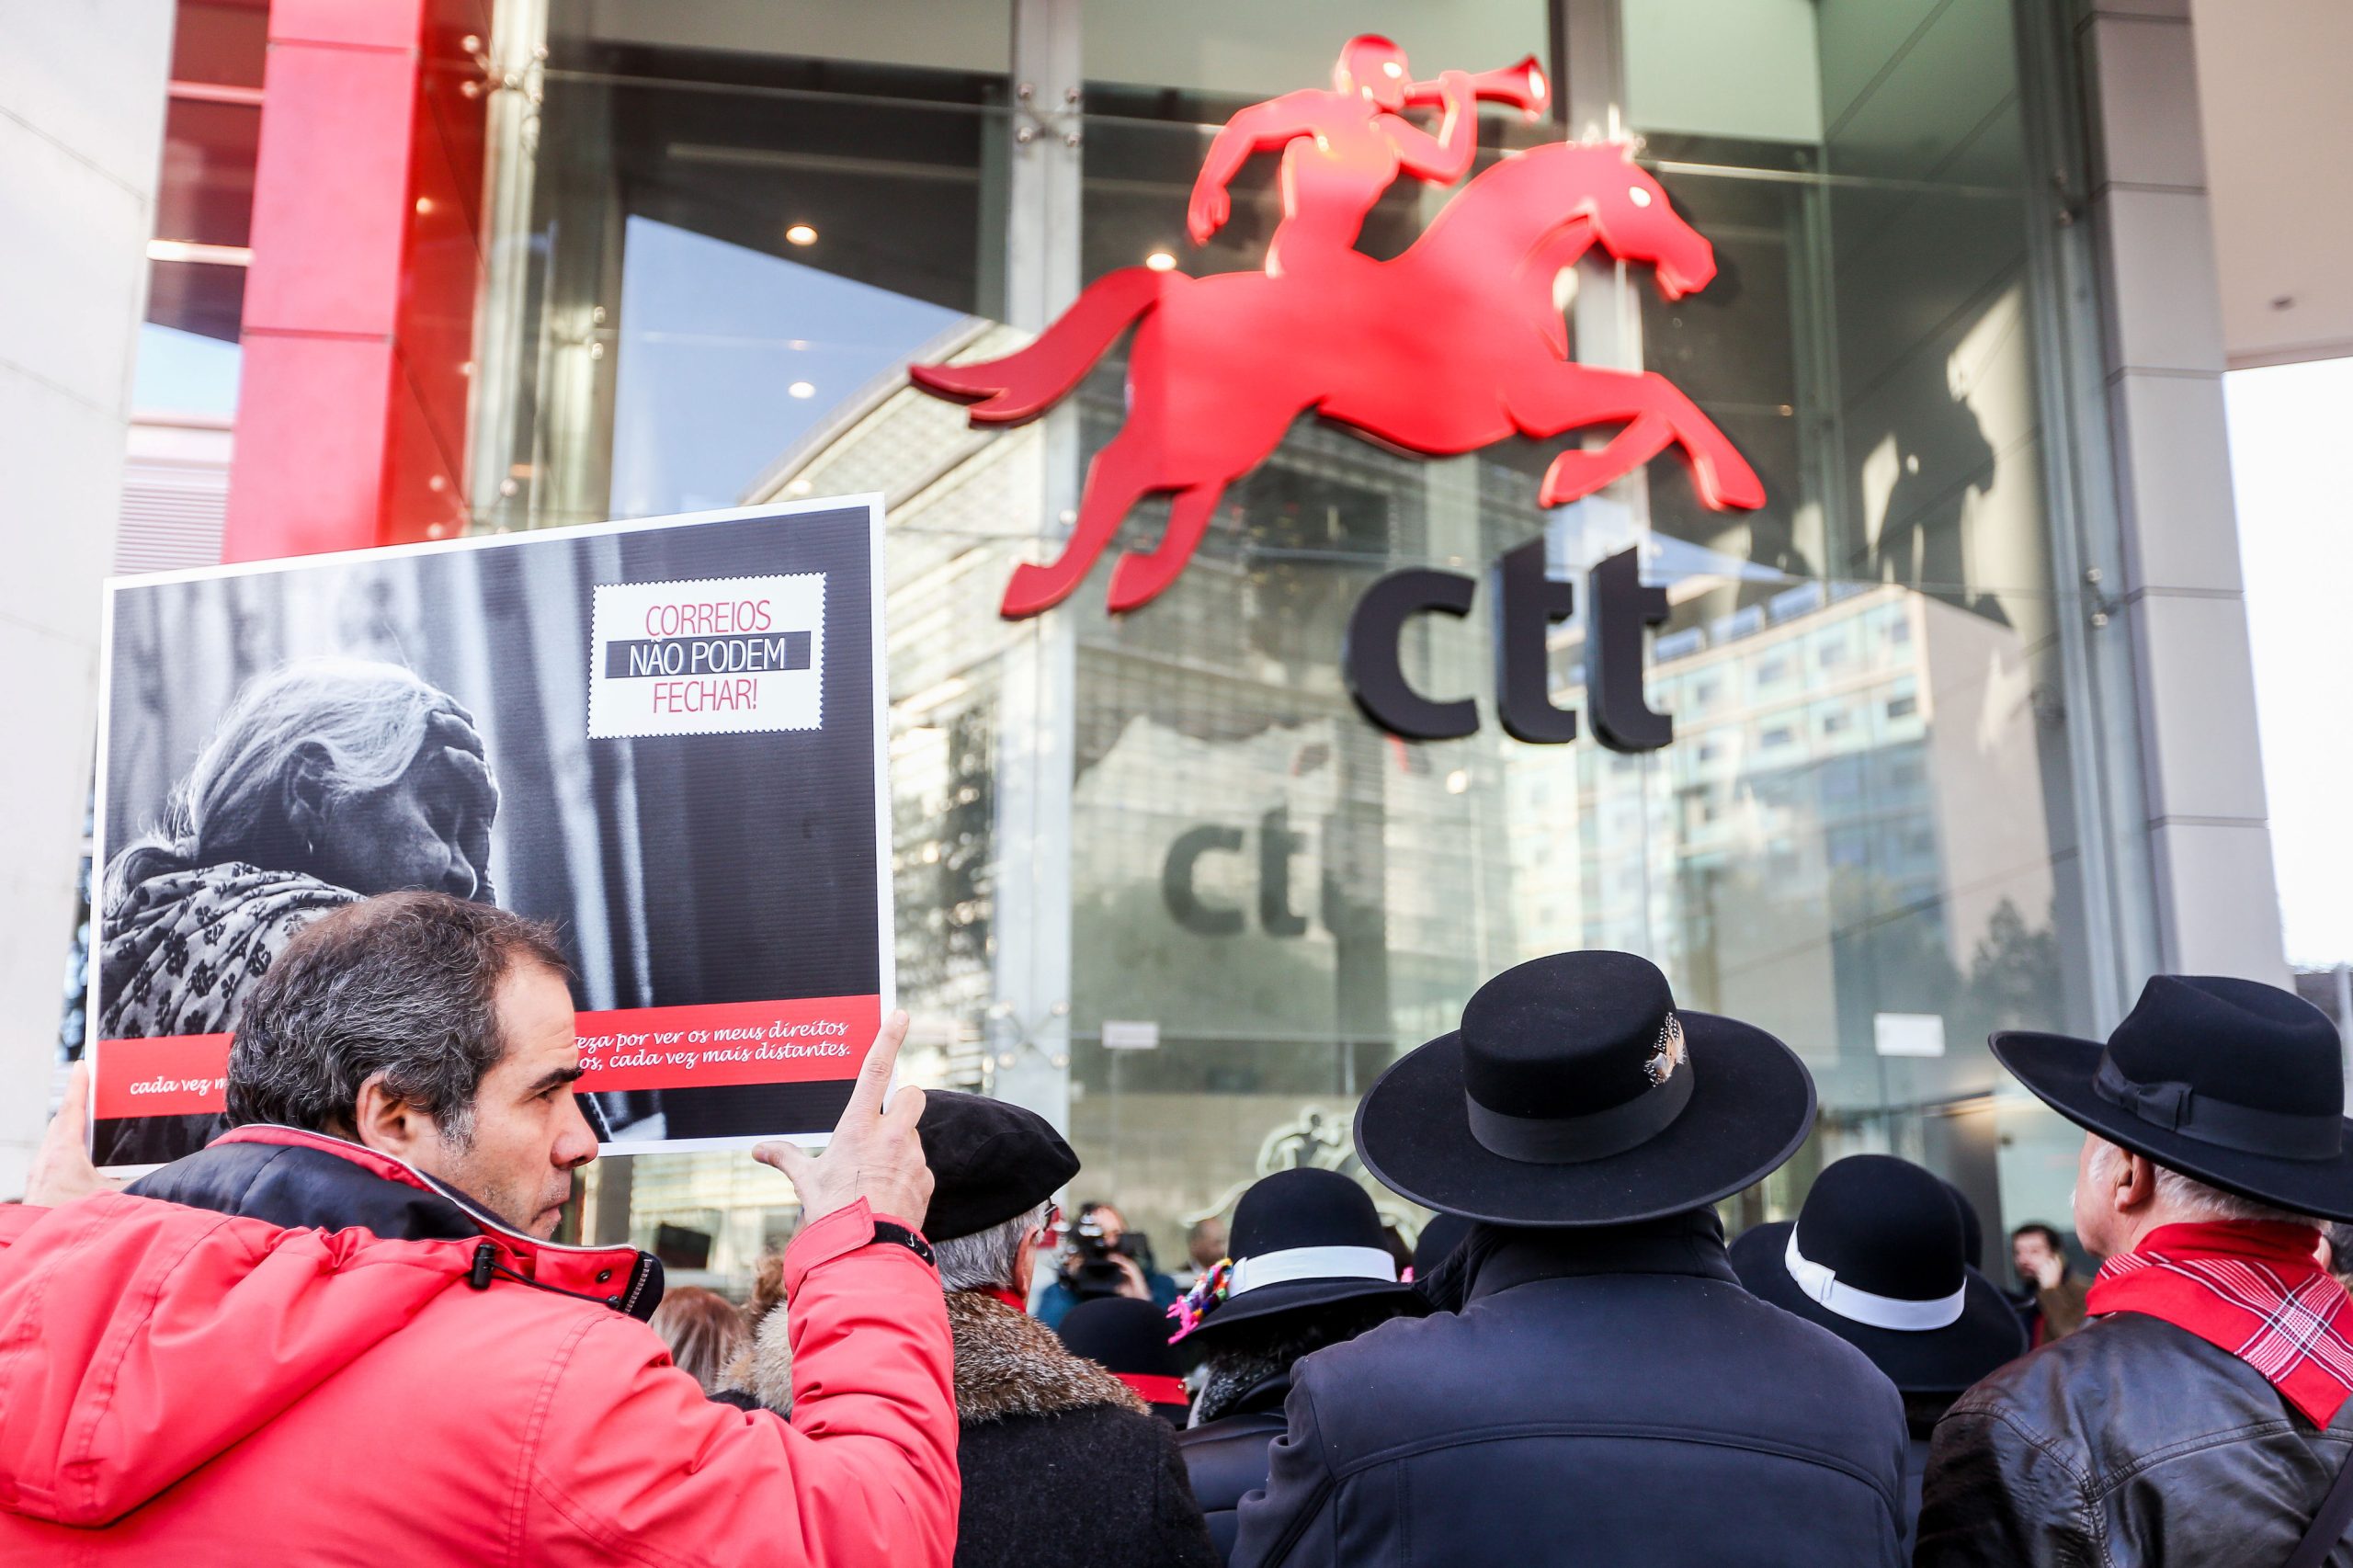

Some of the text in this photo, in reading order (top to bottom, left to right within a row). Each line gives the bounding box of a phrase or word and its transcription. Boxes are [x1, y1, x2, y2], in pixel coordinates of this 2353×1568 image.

[646, 599, 771, 636] CORREIOS
[630, 637, 786, 676] NÃO PODEM
[1344, 537, 1673, 752] ctt
[654, 678, 758, 713] FECHAR!
[616, 1032, 650, 1052] por
[654, 1031, 685, 1045] ver
[688, 1028, 710, 1044] os
[713, 1027, 767, 1041] meus
[768, 1019, 848, 1038] direitos
[130, 1075, 179, 1095] cada
[181, 1078, 212, 1096] vez
[579, 1056, 603, 1071] os,
[609, 1049, 664, 1068] cada
[665, 1051, 699, 1070] vez
[702, 1046, 753, 1062] mais
[755, 1040, 851, 1060] distantes.
